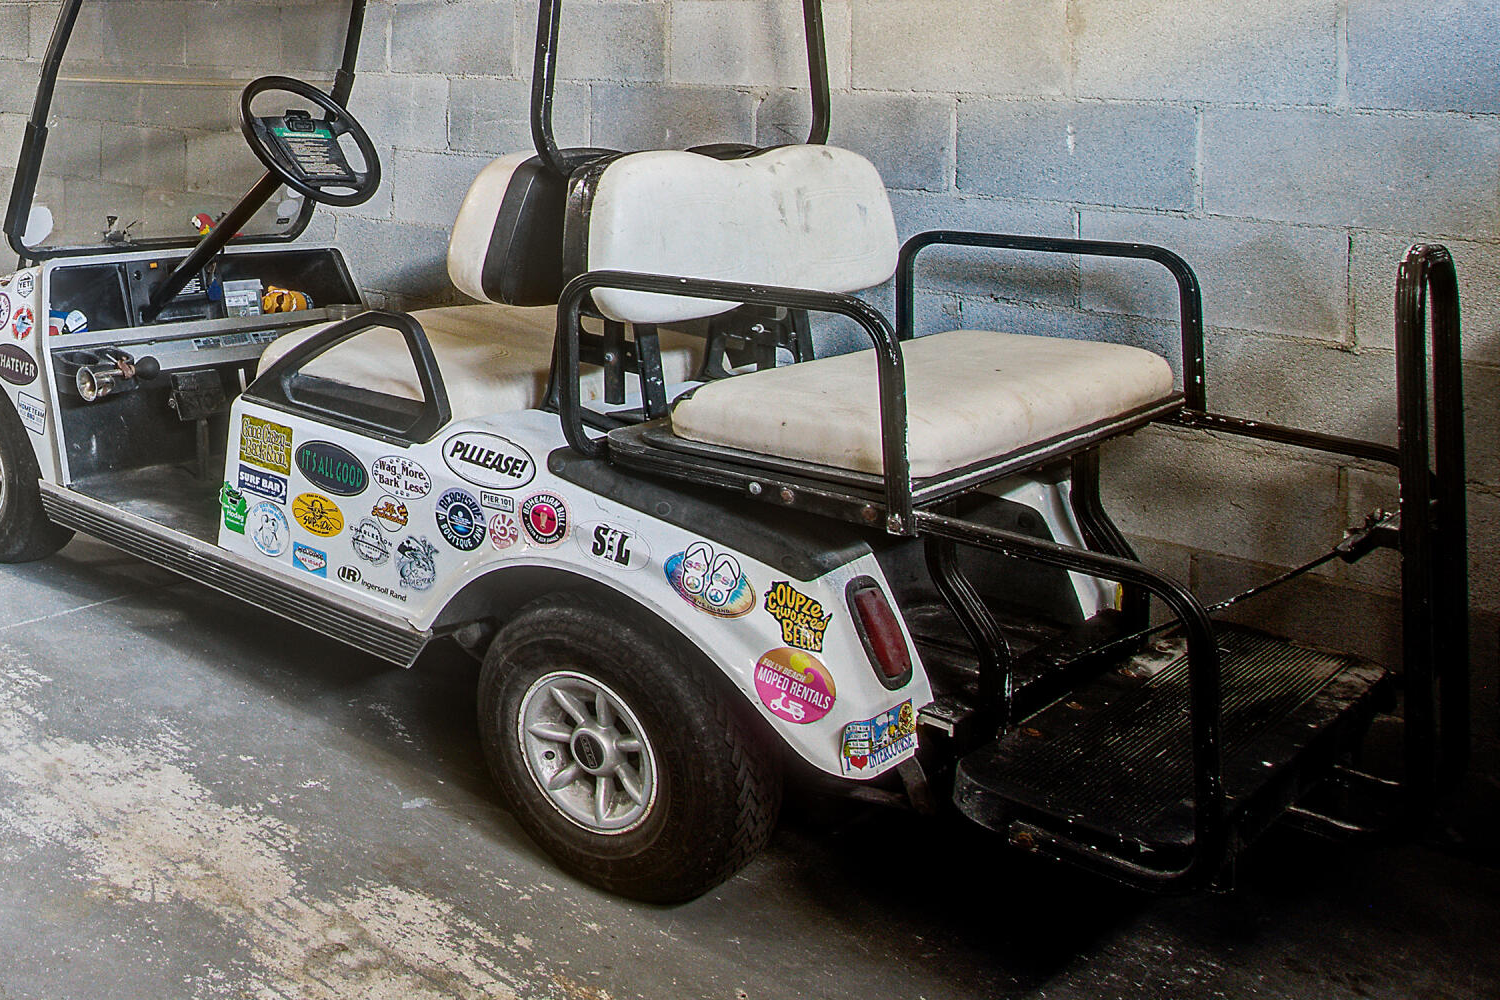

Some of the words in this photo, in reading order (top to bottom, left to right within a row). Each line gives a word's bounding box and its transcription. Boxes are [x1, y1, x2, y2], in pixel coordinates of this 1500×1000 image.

[318, 455, 334, 480] ALL
[335, 461, 364, 488] GOOD
[378, 473, 400, 488] Bark
[379, 460, 397, 476] Wag
[239, 471, 261, 485] SURF
[261, 478, 281, 493] BAR
[483, 493, 499, 503] PIER
[500, 498, 512, 507] 101
[523, 495, 560, 514] BOHEMIAN
[556, 505, 566, 527] BULL
[440, 523, 473, 550] BOUTIQUE
[473, 525, 485, 543] INN
[341, 566, 358, 582] IR
[361, 578, 388, 595] Ingersoll
[389, 589, 407, 602] Rand
[781, 618, 822, 652] BEERS
[762, 657, 784, 672] FOLLY
[782, 666, 807, 683] BEACH
[757, 665, 790, 692] MOPED
[789, 679, 831, 710] RENTALS
